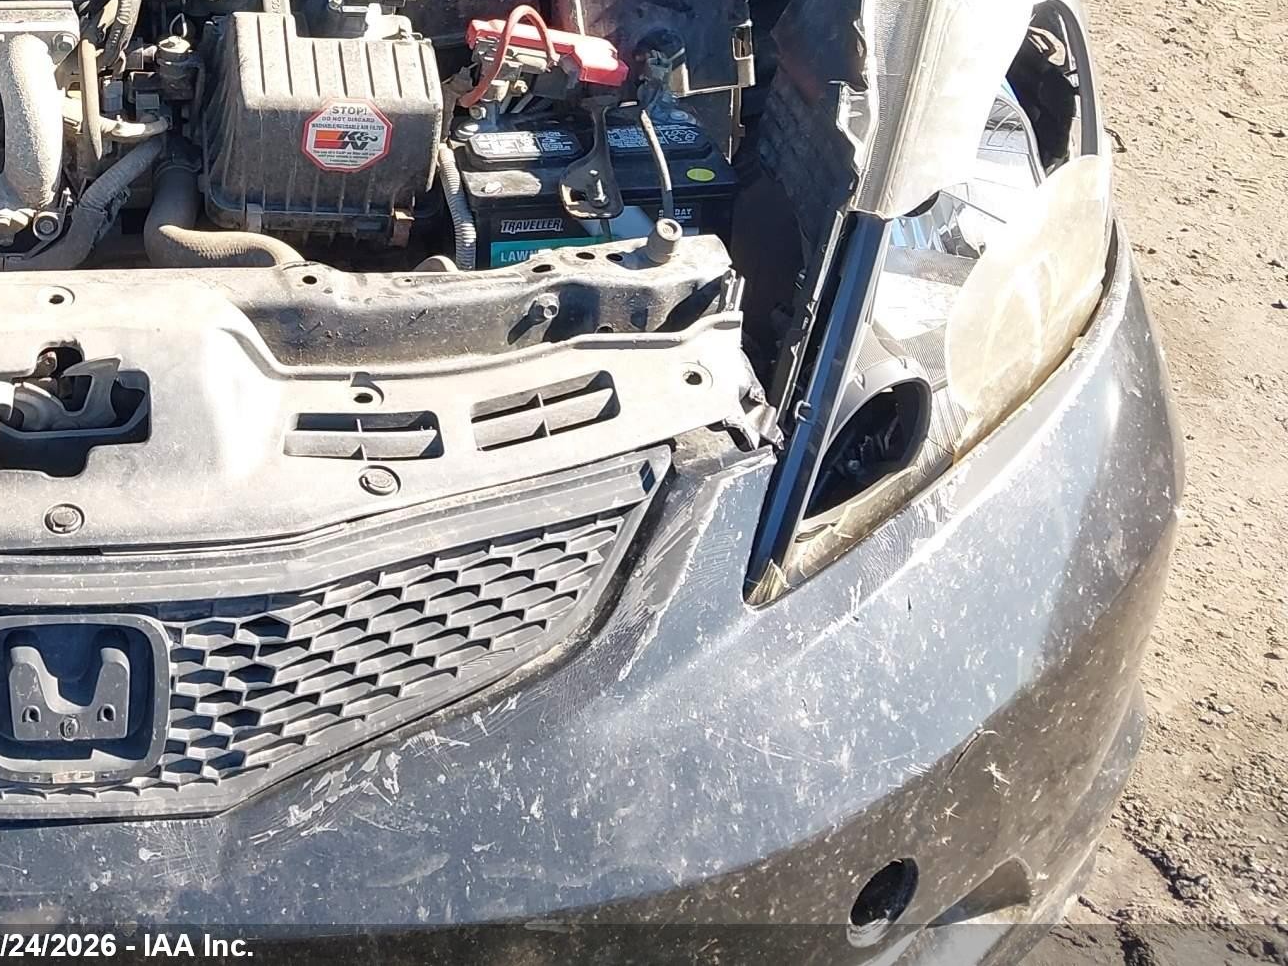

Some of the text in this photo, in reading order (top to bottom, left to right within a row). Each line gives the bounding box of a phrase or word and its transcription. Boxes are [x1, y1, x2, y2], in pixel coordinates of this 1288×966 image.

[332, 106, 367, 115] STOP!
[674, 208, 692, 216] DAY
[500, 218, 562, 234] TRAVELLER
